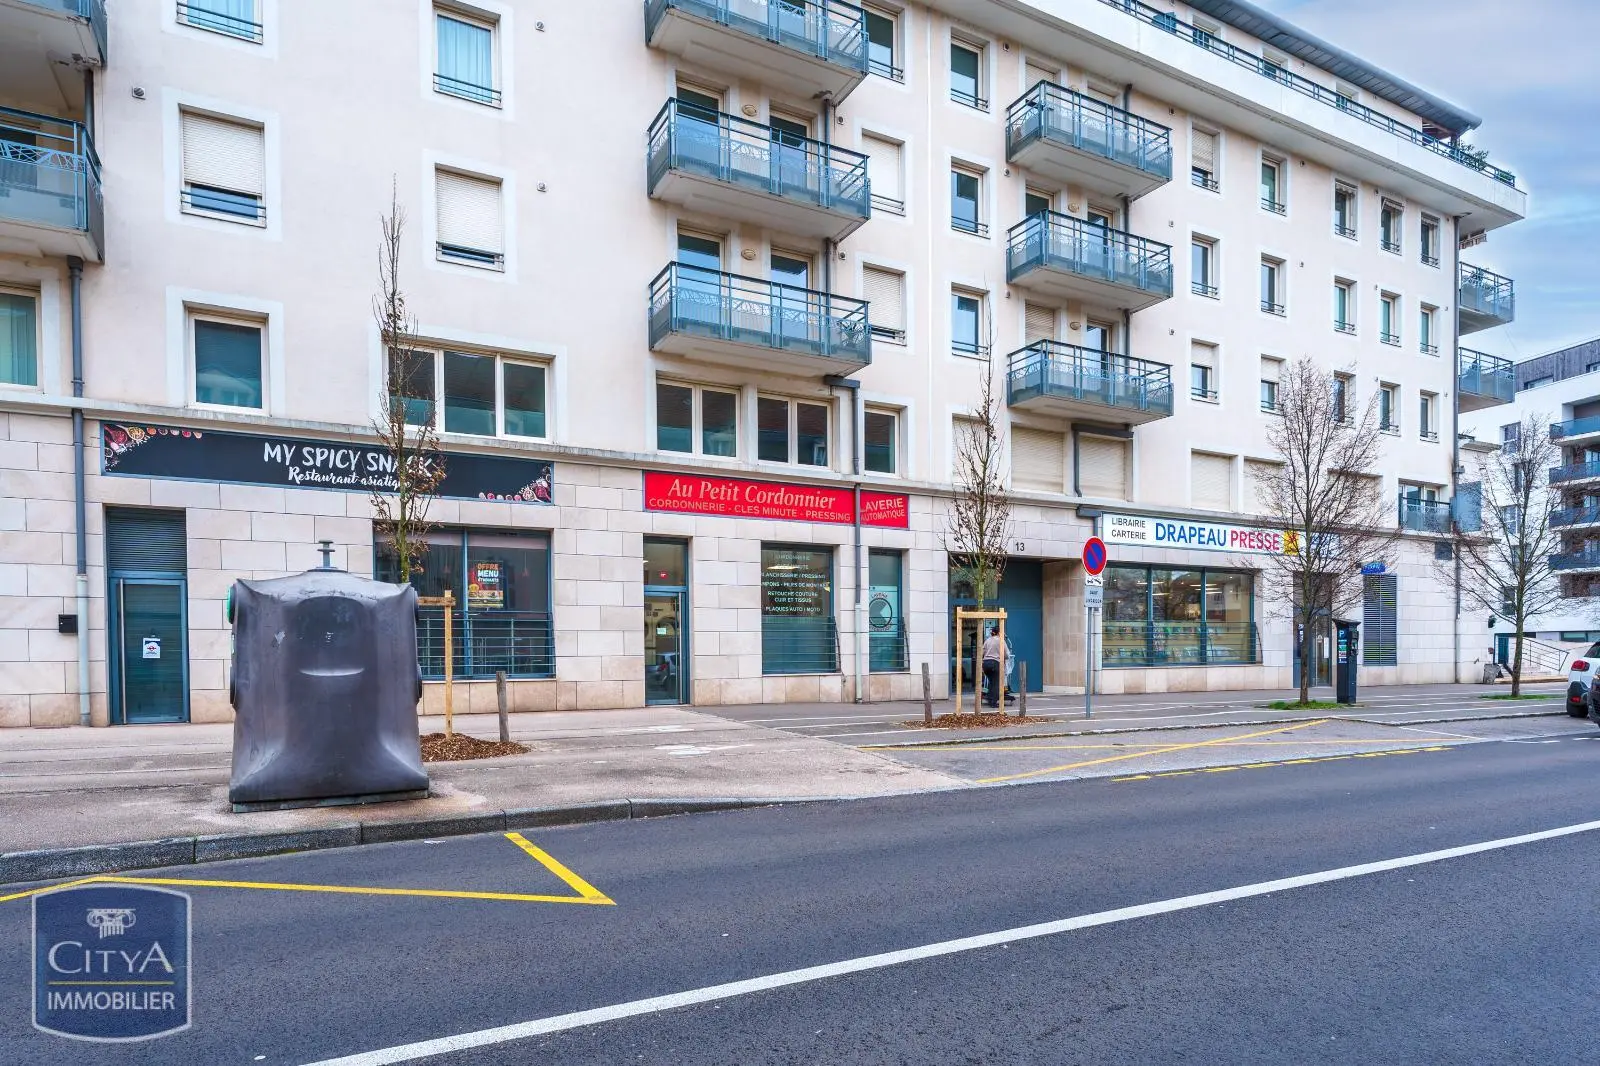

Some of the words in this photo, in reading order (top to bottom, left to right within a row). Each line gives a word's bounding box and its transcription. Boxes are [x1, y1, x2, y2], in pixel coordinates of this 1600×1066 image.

[263, 441, 296, 466] MY
[302, 446, 361, 471] SPICY
[287, 466, 359, 484] Restaurant
[360, 474, 411, 491] asiatiqe
[667, 478, 693, 498] Au
[699, 480, 739, 501] Petit
[745, 485, 836, 510] Cordonnier
[649, 498, 725, 512] CORDONNERIE
[734, 504, 760, 514] CLES
[762, 507, 797, 518] MINUTE
[805, 510, 851, 522] PRESSING
[1111, 517, 1146, 528] LIBRAIRIE
[1111, 529, 1147, 540] CARTERIE
[1015, 542, 1025, 551] 13
[1155, 522, 1227, 547] DRAPEAU
[1230, 529, 1280, 550] PRESSE
[477, 569, 499, 578] MENU
